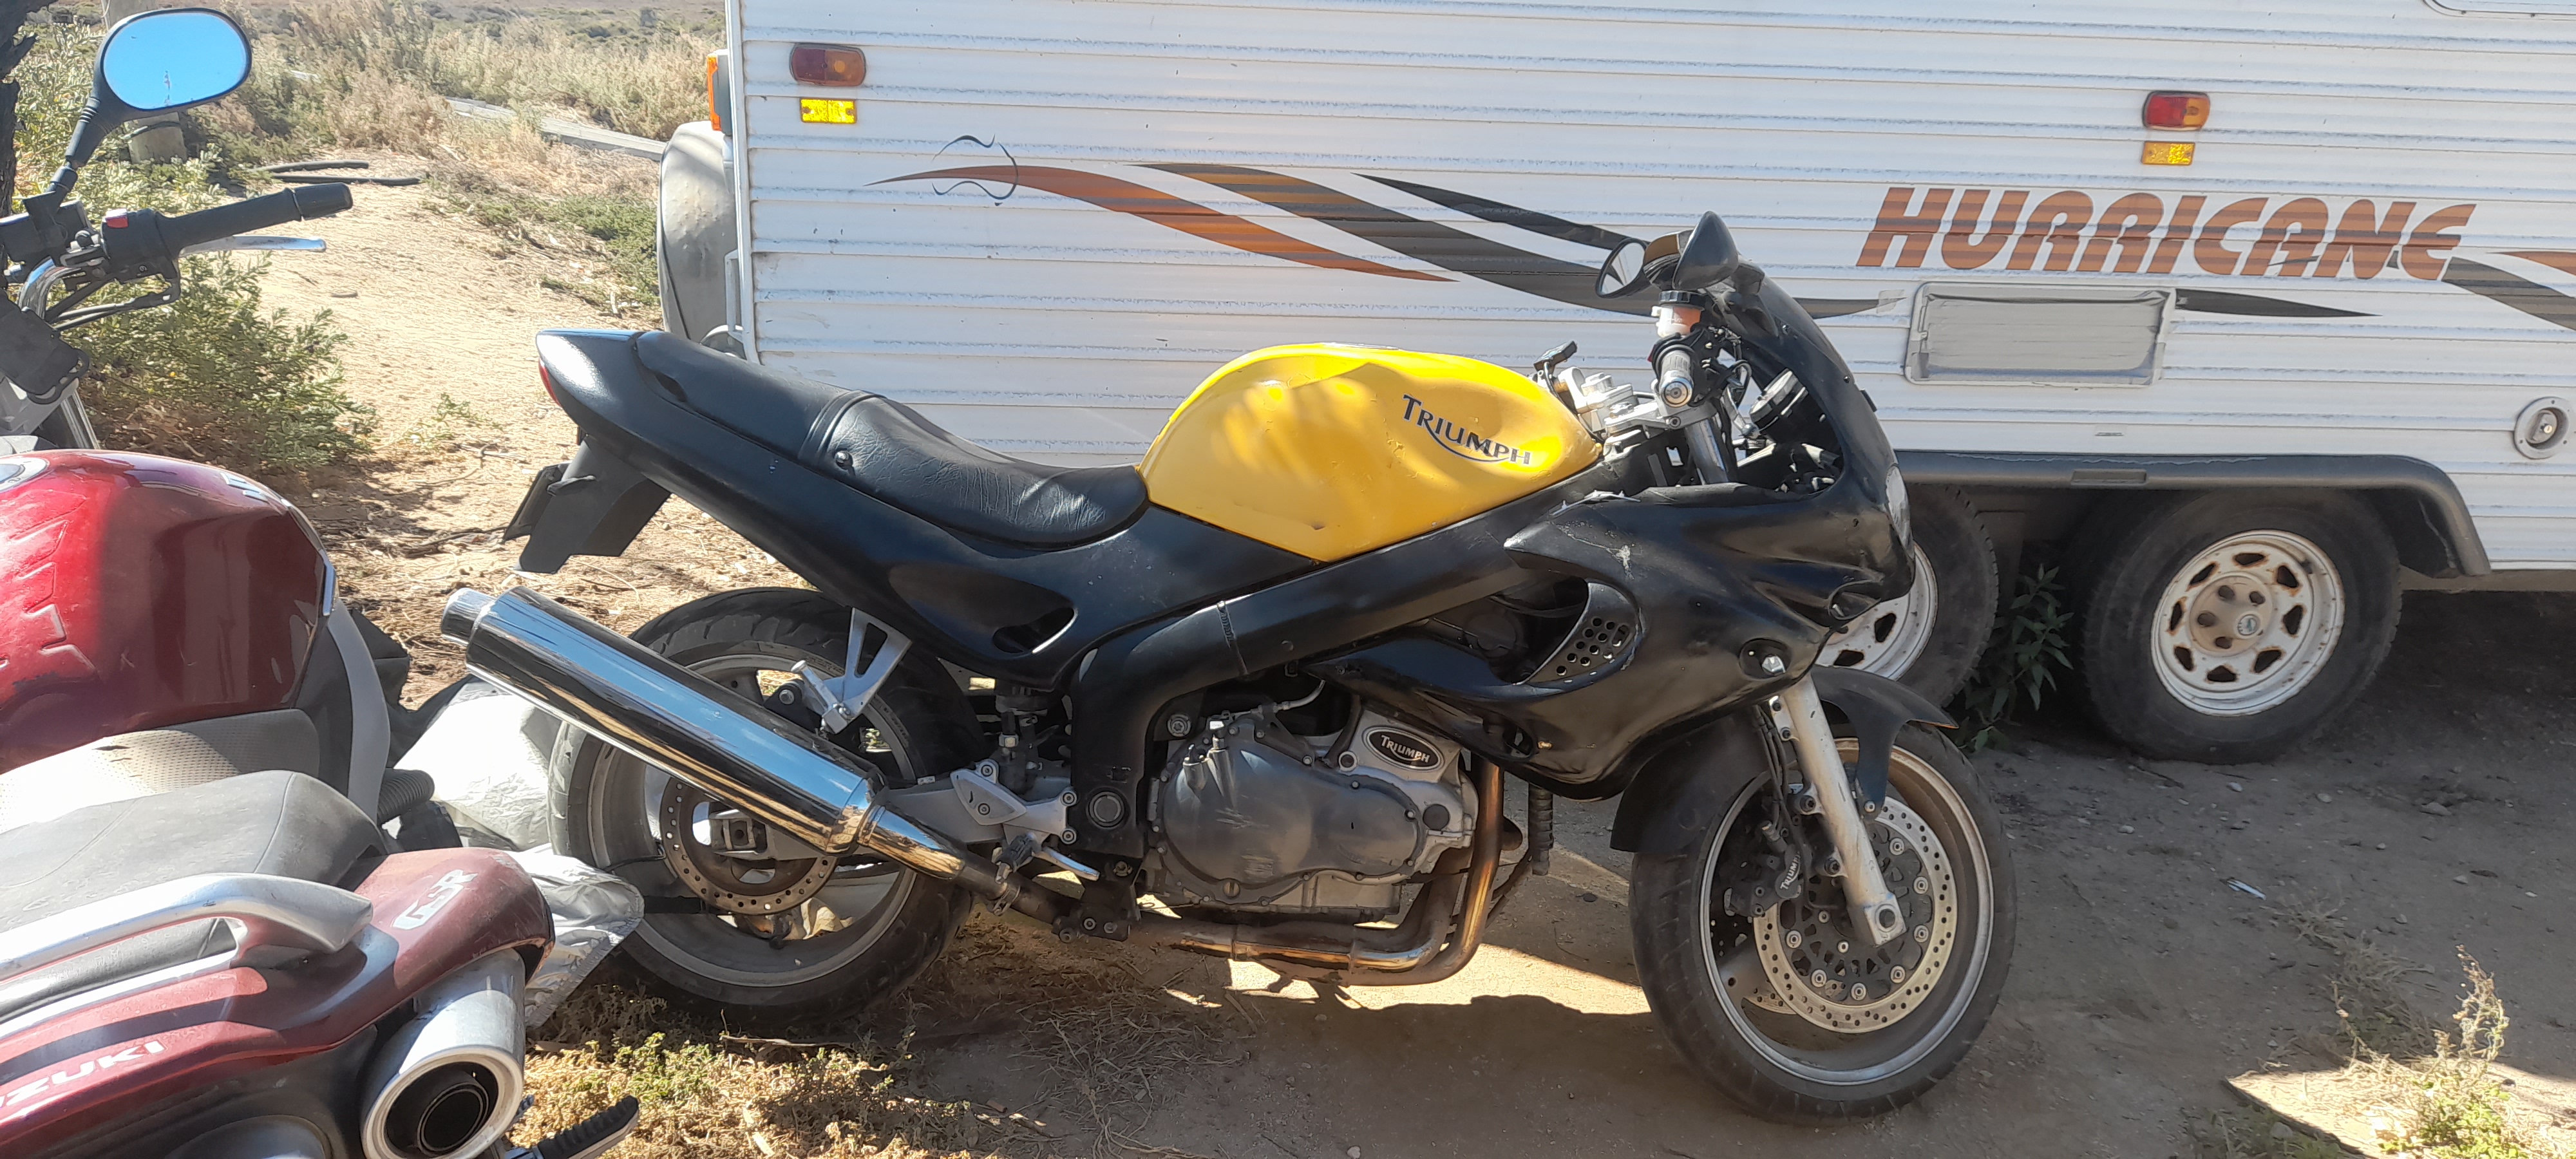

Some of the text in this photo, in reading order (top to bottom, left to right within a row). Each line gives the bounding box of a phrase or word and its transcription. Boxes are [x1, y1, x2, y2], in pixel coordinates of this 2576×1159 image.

[1855, 187, 2477, 280] HURRICANE
[1403, 393, 1531, 465] TRIUMPH
[1381, 735, 1430, 763] TRIUMPH
[0, 1041, 165, 1108] ZUKI
